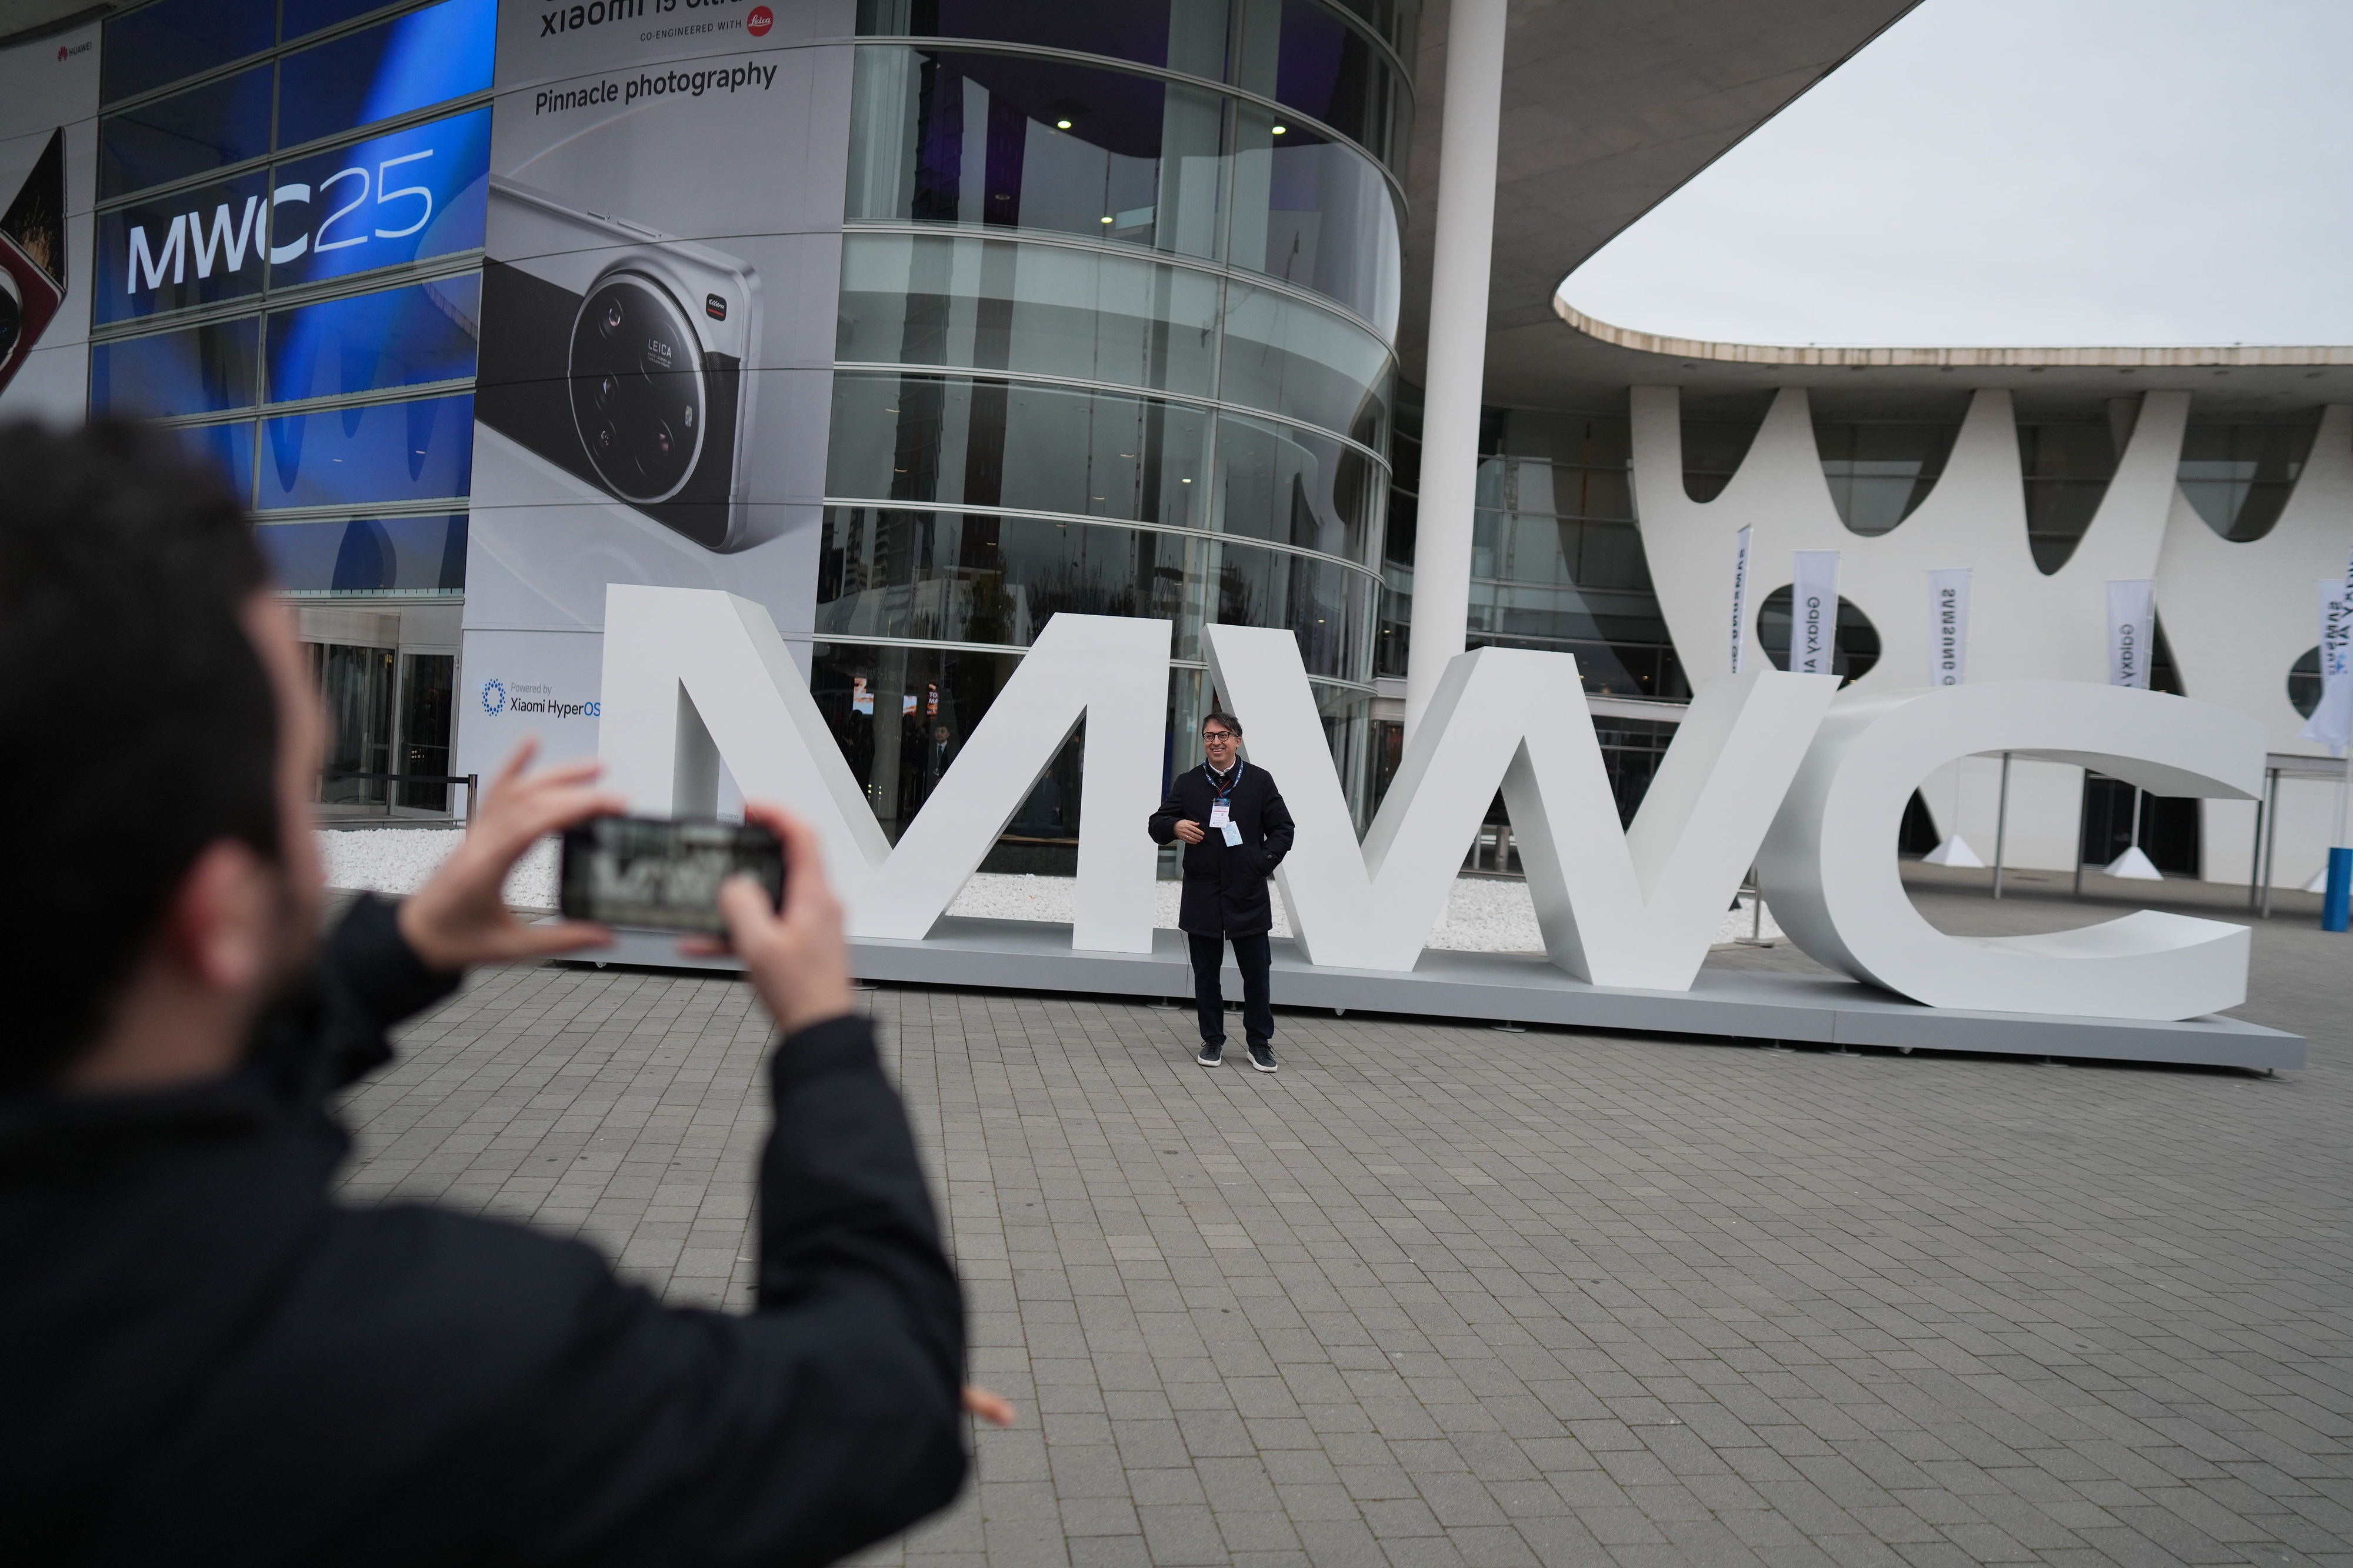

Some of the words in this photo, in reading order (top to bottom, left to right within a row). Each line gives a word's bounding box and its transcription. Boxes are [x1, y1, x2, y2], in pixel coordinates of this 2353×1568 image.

[640, 23, 714, 42] CO-ENGINEERED
[718, 19, 742, 30] WITH
[748, 14, 772, 27] Leica
[69, 41, 92, 56] HUAWEI
[535, 80, 618, 116] Pinnacle
[625, 61, 778, 105] photography
[128, 149, 434, 295] MWC25
[648, 338, 672, 358] LEICA
[511, 682, 541, 693] Powered
[543, 684, 552, 696] by
[510, 697, 545, 713] Xiaomi
[548, 699, 601, 719] HyperOS
[594, 582, 2271, 1023] MWC
